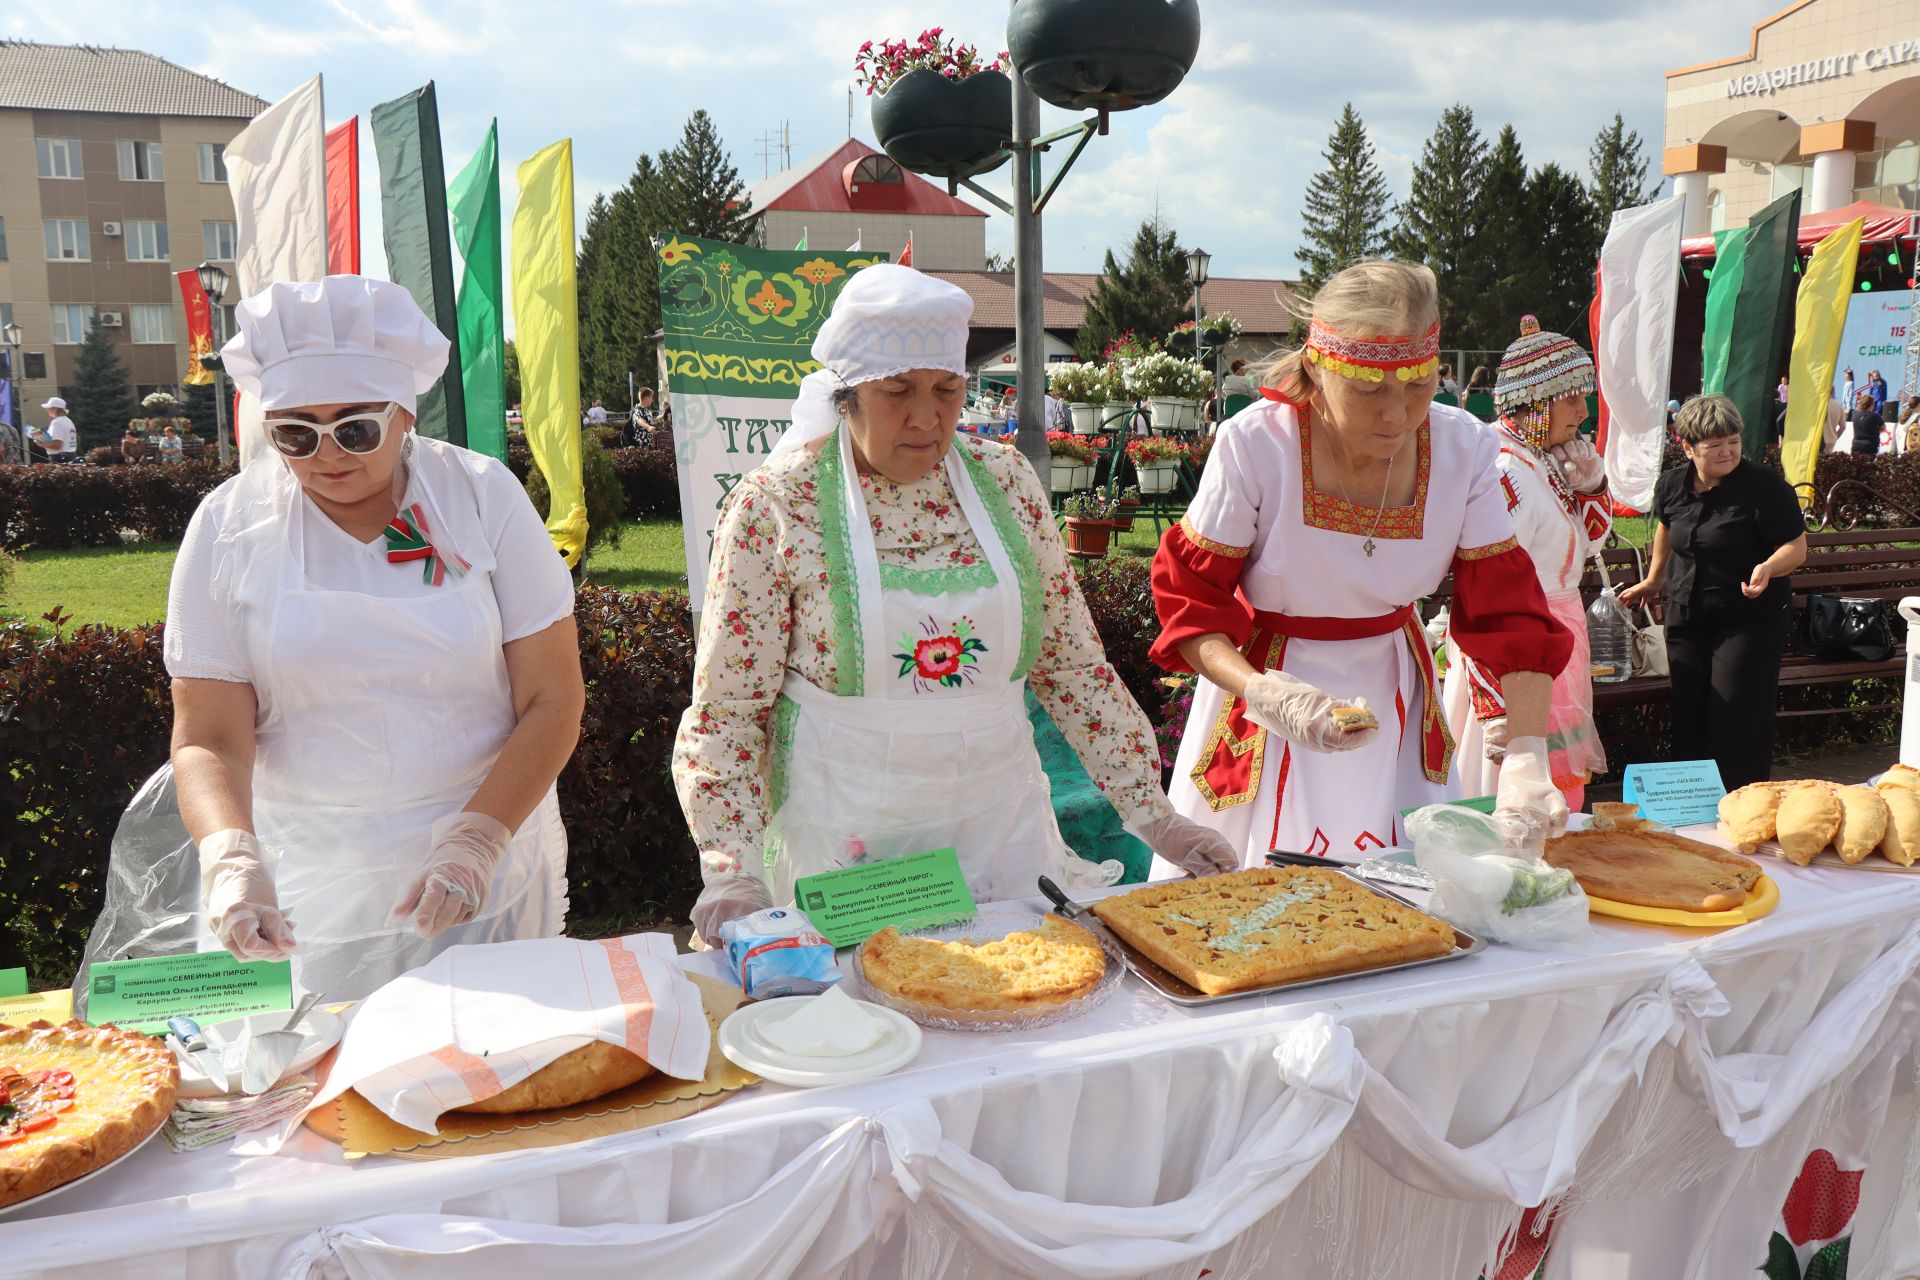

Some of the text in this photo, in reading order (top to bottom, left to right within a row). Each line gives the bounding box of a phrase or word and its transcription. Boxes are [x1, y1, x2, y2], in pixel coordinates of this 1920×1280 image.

[1890, 326, 1906, 337] 115
[1859, 342, 1902, 357] С ДНЁМ
[907, 894, 921, 902] дом
[921, 888, 953, 899] культуры
[831, 897, 875, 911] Валиуллина
[168, 970, 221, 982] «СЕМЕЙНЫЙ
[223, 968, 255, 977] ПИРОГ»
[121, 981, 258, 1000] Савельева Ольга Геннадьевна
[136, 996, 181, 1005] Караульно
[189, 992, 222, 1000] горский
[196, 1001, 240, 1010] «РЫБНИК»
